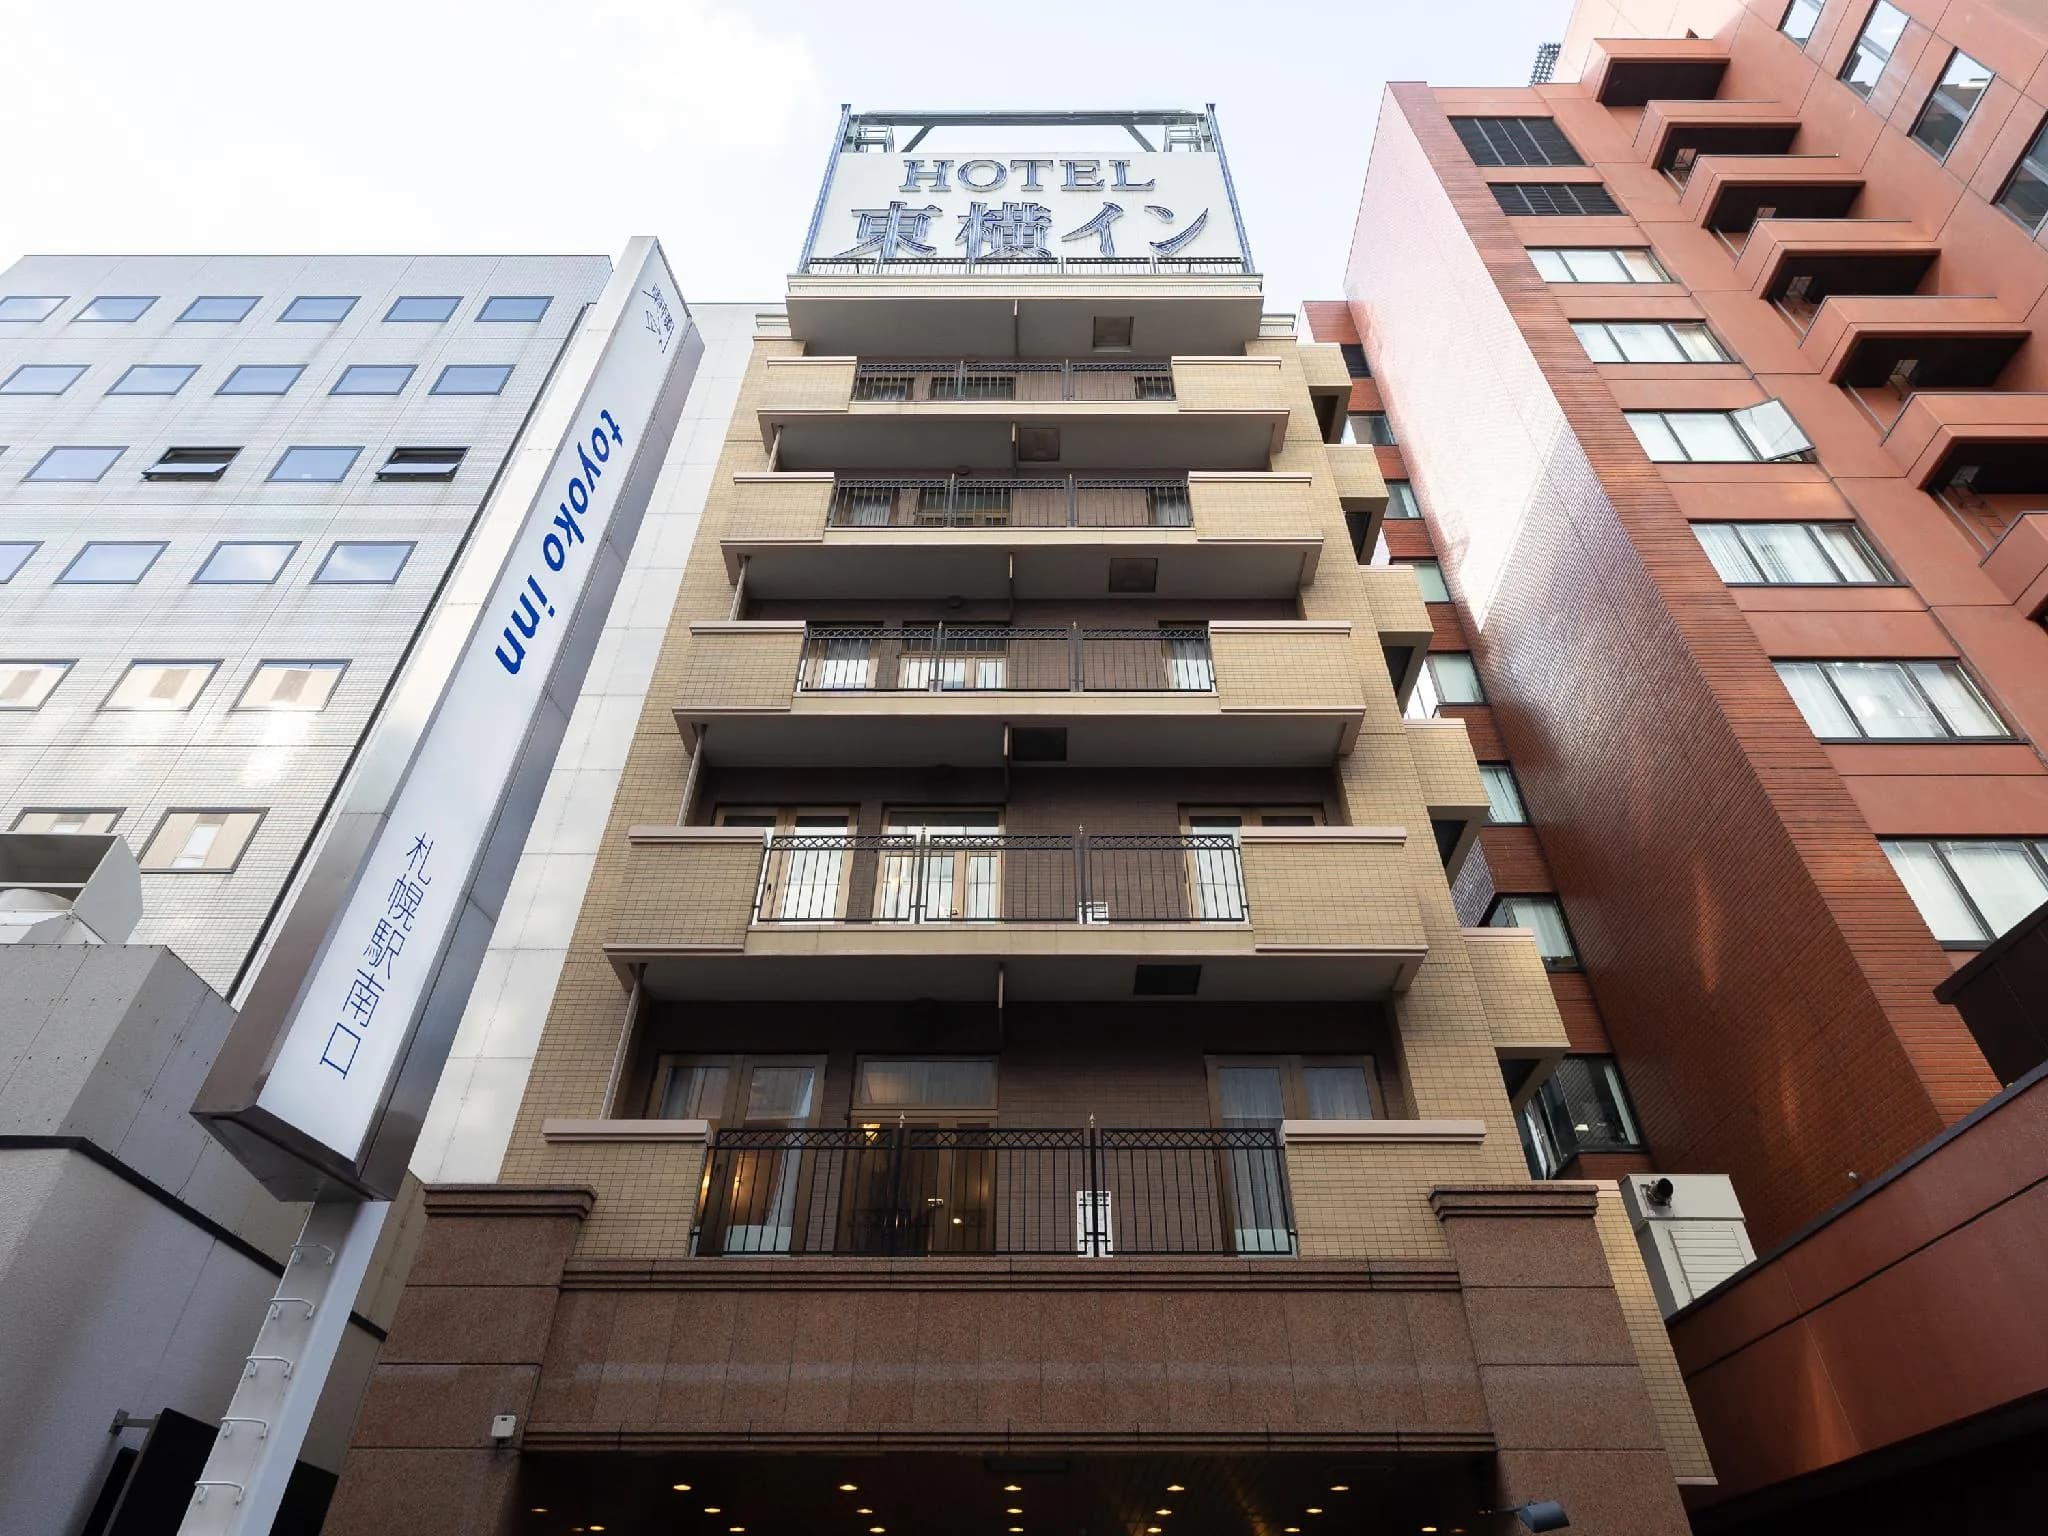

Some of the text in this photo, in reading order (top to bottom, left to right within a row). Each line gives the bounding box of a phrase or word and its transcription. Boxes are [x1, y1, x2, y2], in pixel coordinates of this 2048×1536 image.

[834, 201, 1209, 258] 東横イン
[899, 159, 1156, 192] HOTEL
[495, 410, 623, 675] toyoko inn
[320, 833, 433, 1079] 札幌駅南口
